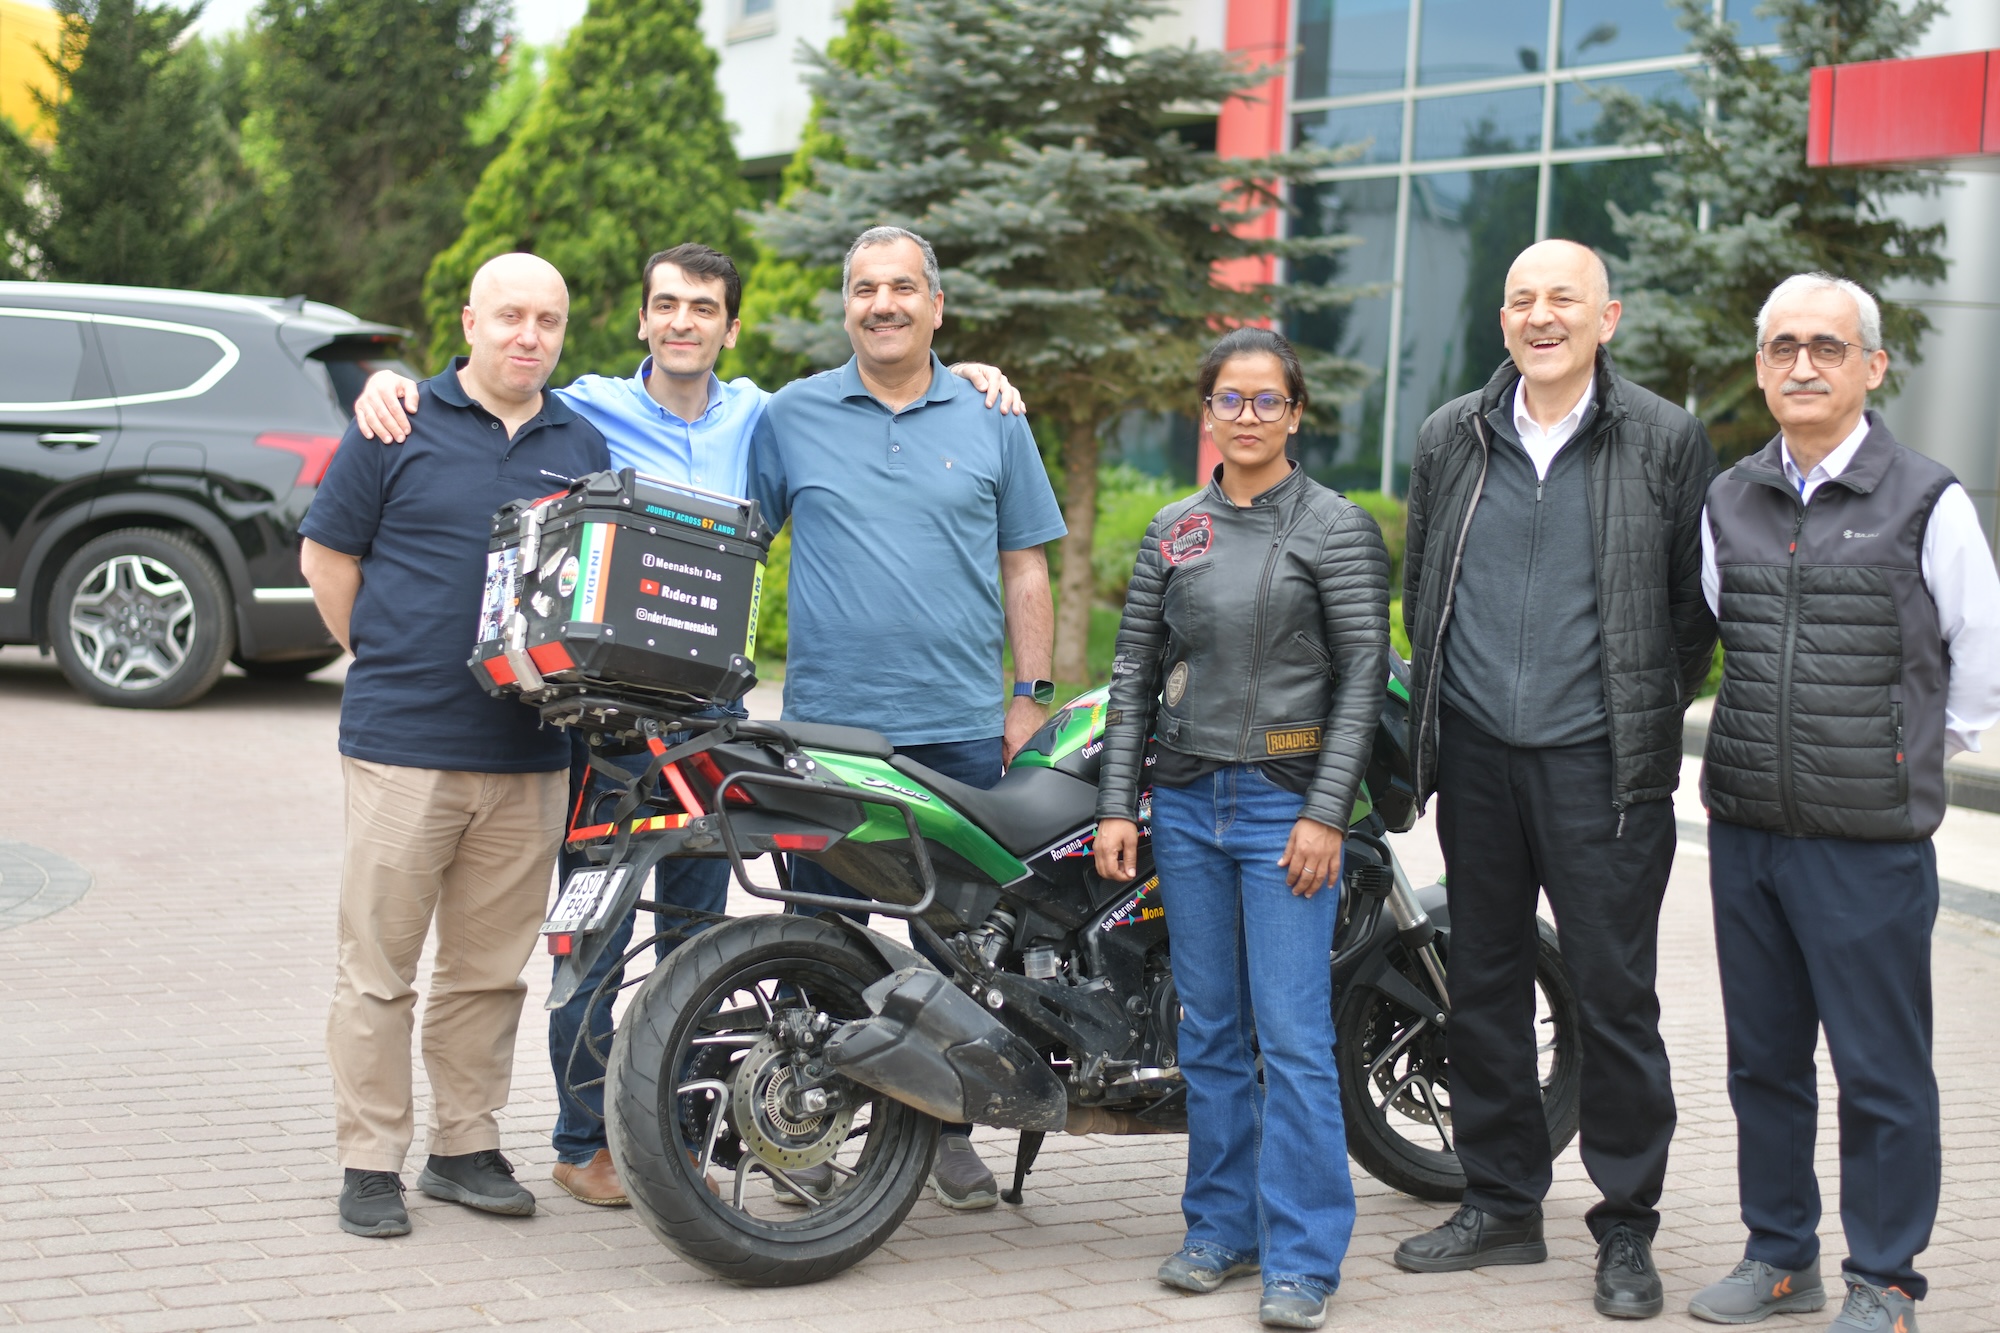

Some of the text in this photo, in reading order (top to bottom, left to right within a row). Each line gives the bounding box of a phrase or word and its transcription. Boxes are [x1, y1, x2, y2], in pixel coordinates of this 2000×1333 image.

[645, 504, 736, 536] JOURNEY ACROSS 67 LANDS
[1172, 530, 1203, 555] ROADIES
[585, 550, 600, 604] INDIA
[655, 558, 722, 582] Meenakshi Das
[661, 585, 718, 611] Riders MB
[749, 576, 761, 647] ASSAM
[1081, 741, 1104, 759] Oman
[1270, 731, 1316, 751] ROADIES
[1050, 838, 1083, 861] Romania
[1101, 899, 1137, 932] San Marino
[1141, 906, 1165, 920] Mona
